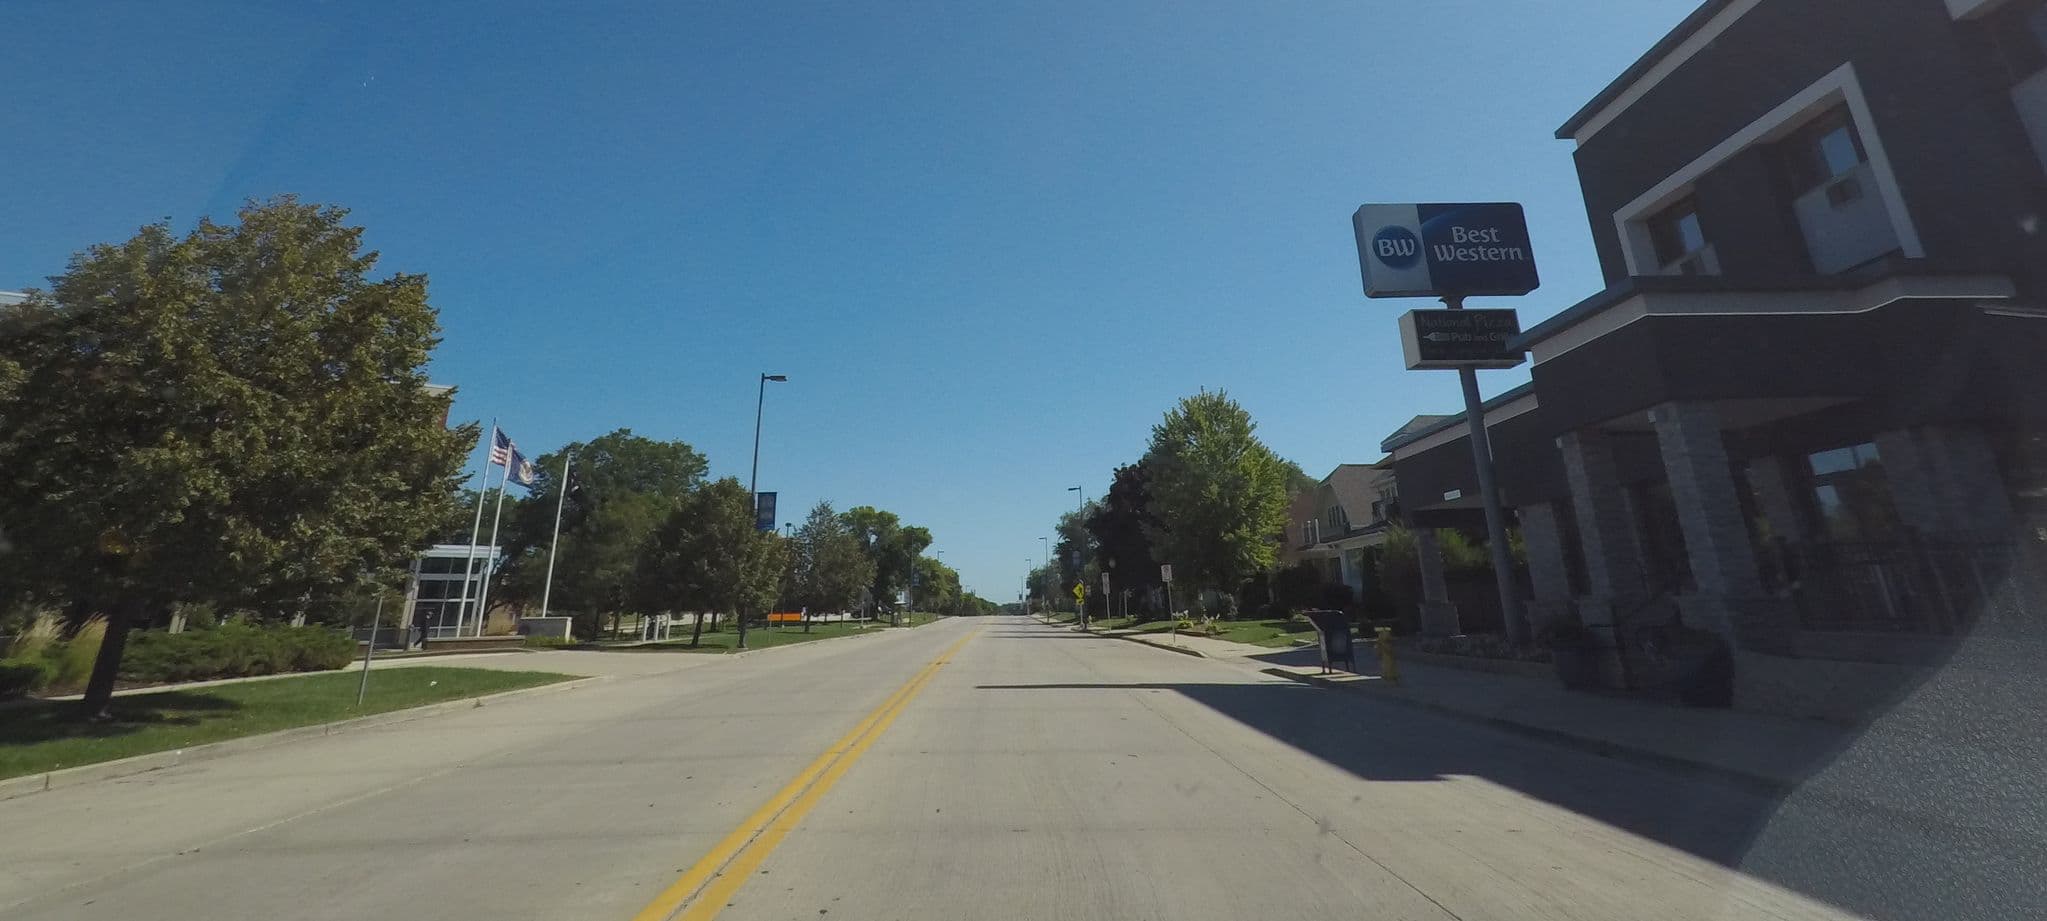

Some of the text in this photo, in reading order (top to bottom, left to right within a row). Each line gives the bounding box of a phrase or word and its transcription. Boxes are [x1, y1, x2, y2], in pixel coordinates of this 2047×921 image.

[1452, 226, 1500, 243] Best
[1379, 239, 1414, 257] BW
[1434, 244, 1523, 262] Western
